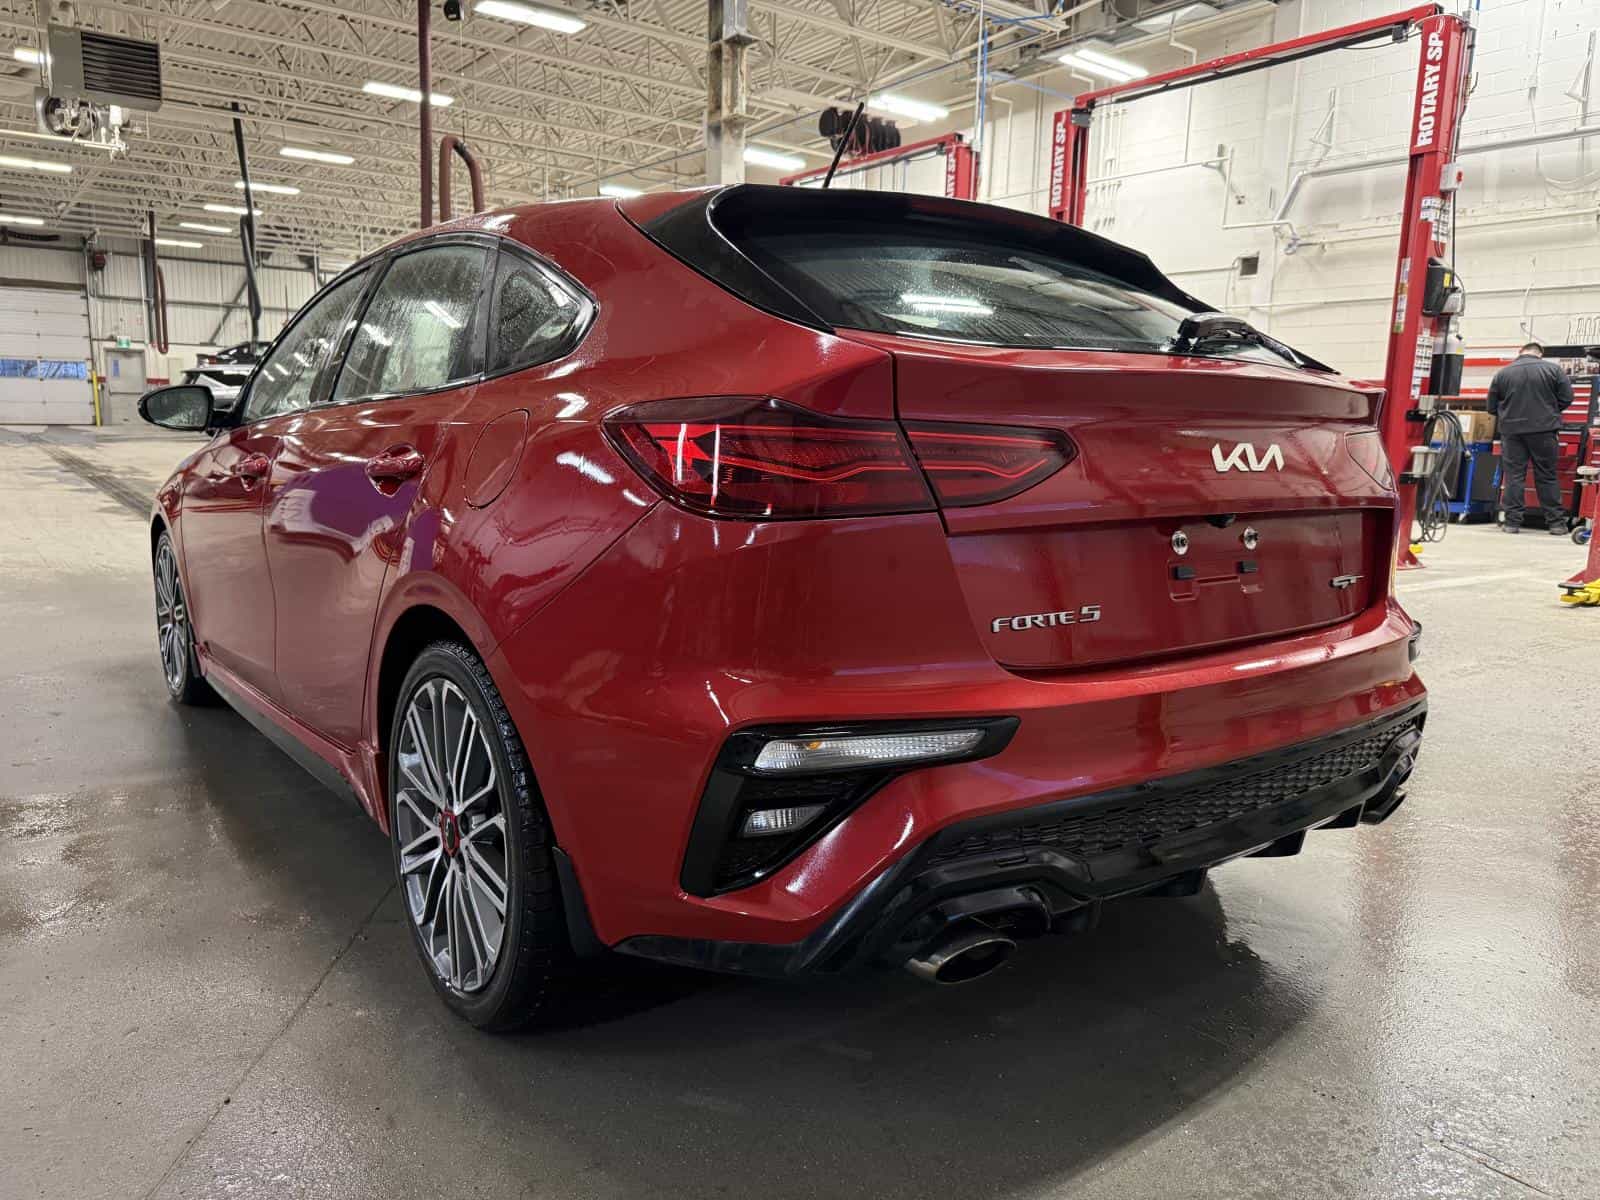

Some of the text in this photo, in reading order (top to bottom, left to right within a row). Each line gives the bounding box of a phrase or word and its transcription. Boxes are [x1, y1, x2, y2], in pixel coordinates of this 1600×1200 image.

[1416, 62, 1441, 148] ROTARY
[1051, 144, 1066, 208] ROTARY
[1211, 443, 1285, 472] KIA
[992, 604, 1102, 633] FORTE 5
